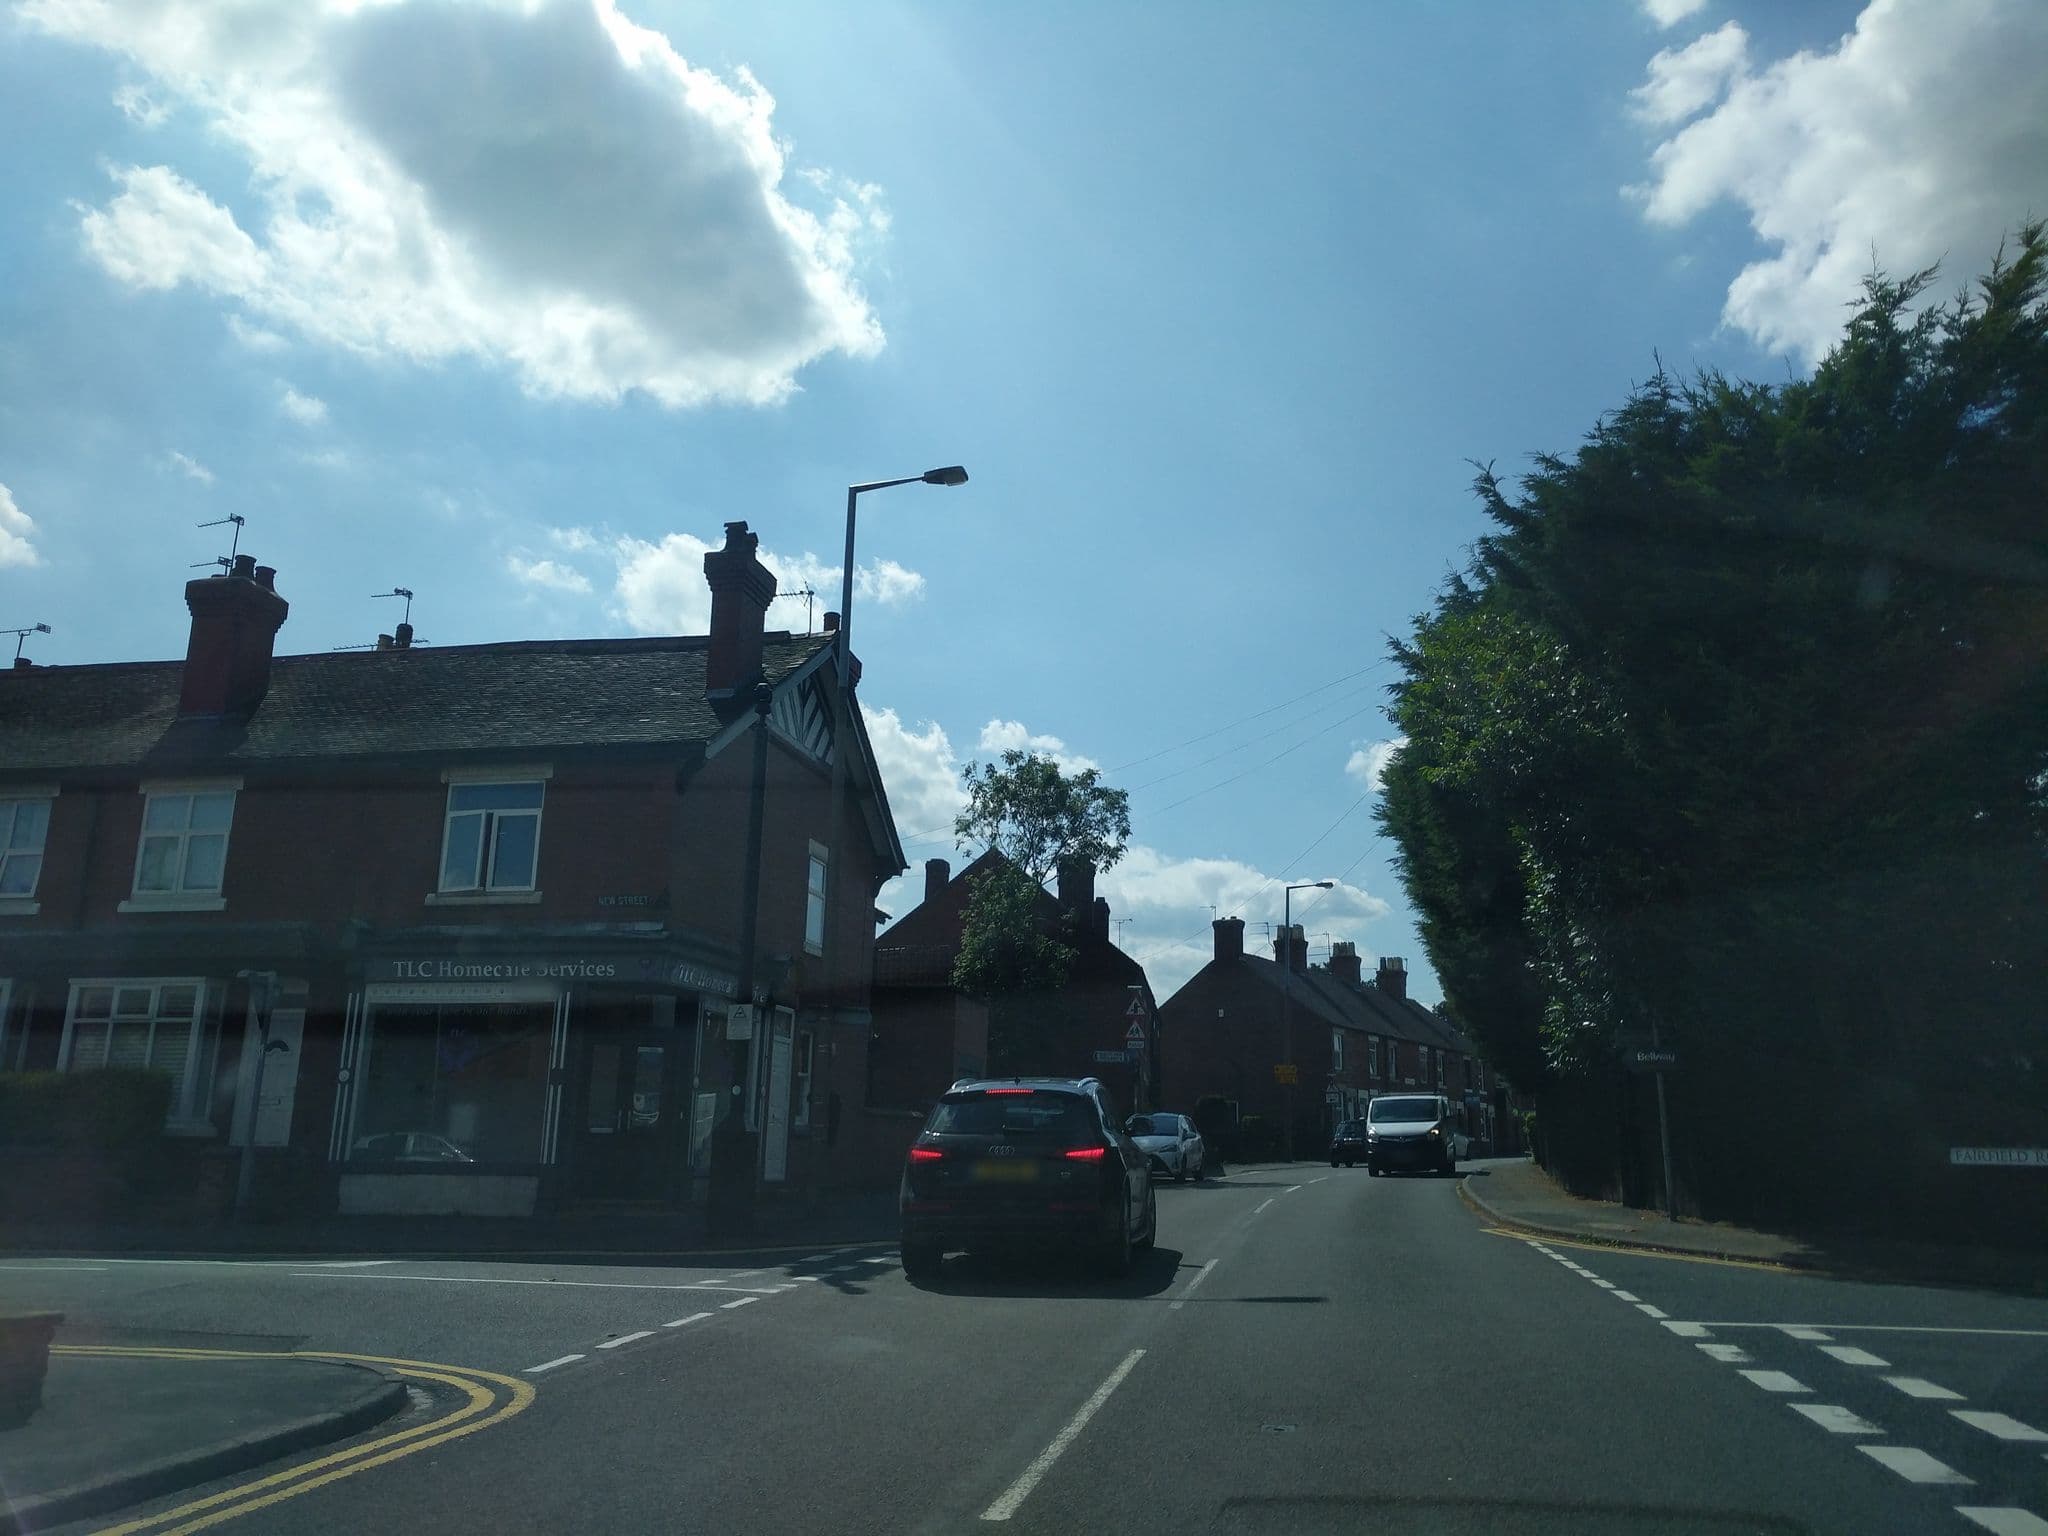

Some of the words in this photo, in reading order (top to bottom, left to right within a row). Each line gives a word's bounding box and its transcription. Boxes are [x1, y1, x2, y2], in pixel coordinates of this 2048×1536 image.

[598, 895, 616, 905] NEW
[618, 895, 649, 905] STREET
[392, 960, 433, 978] TLC
[439, 960, 530, 978] Homecare
[1955, 1150, 2029, 1162] FAIRFIELD
